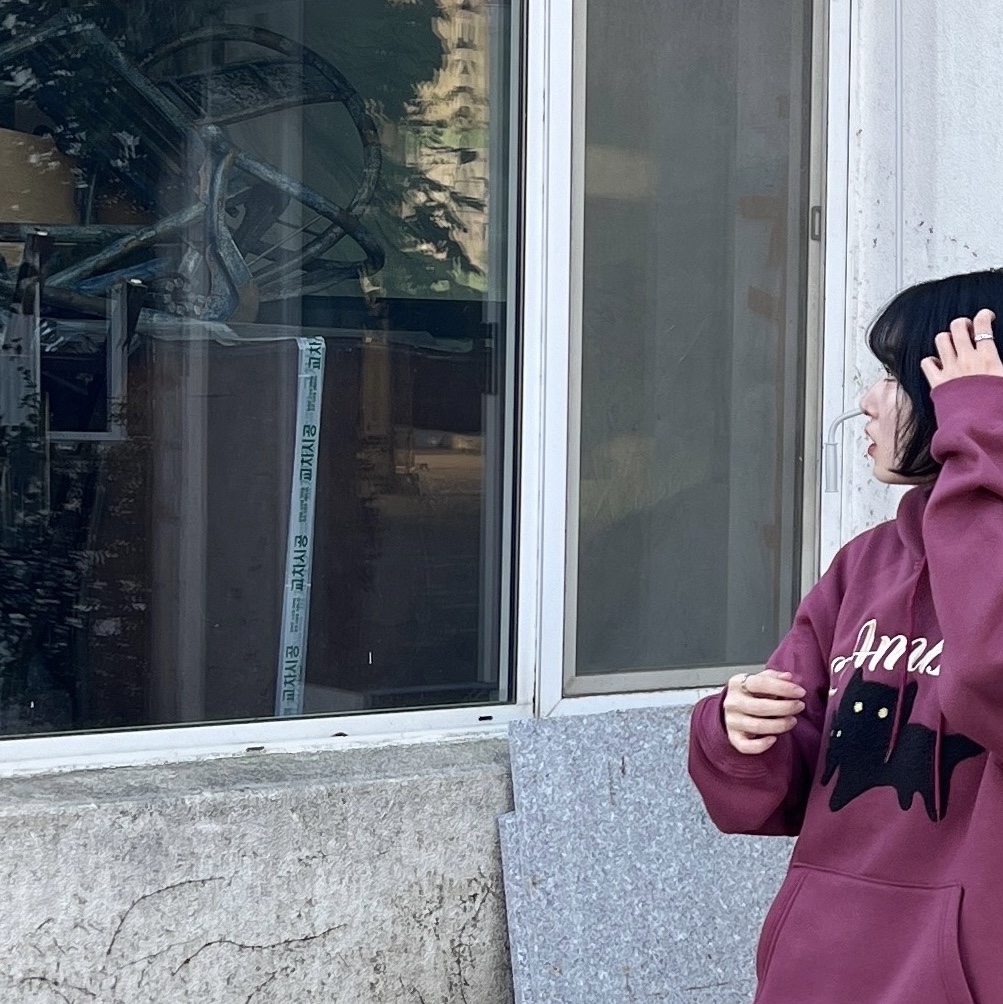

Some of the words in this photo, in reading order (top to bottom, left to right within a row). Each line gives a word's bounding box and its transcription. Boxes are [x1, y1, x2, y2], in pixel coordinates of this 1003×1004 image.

[308, 337, 322, 370] 교차
[300, 425, 317, 481] 교차시공
[291, 535, 308, 591] 교차시공
[282, 645, 300, 701] 교차시공
